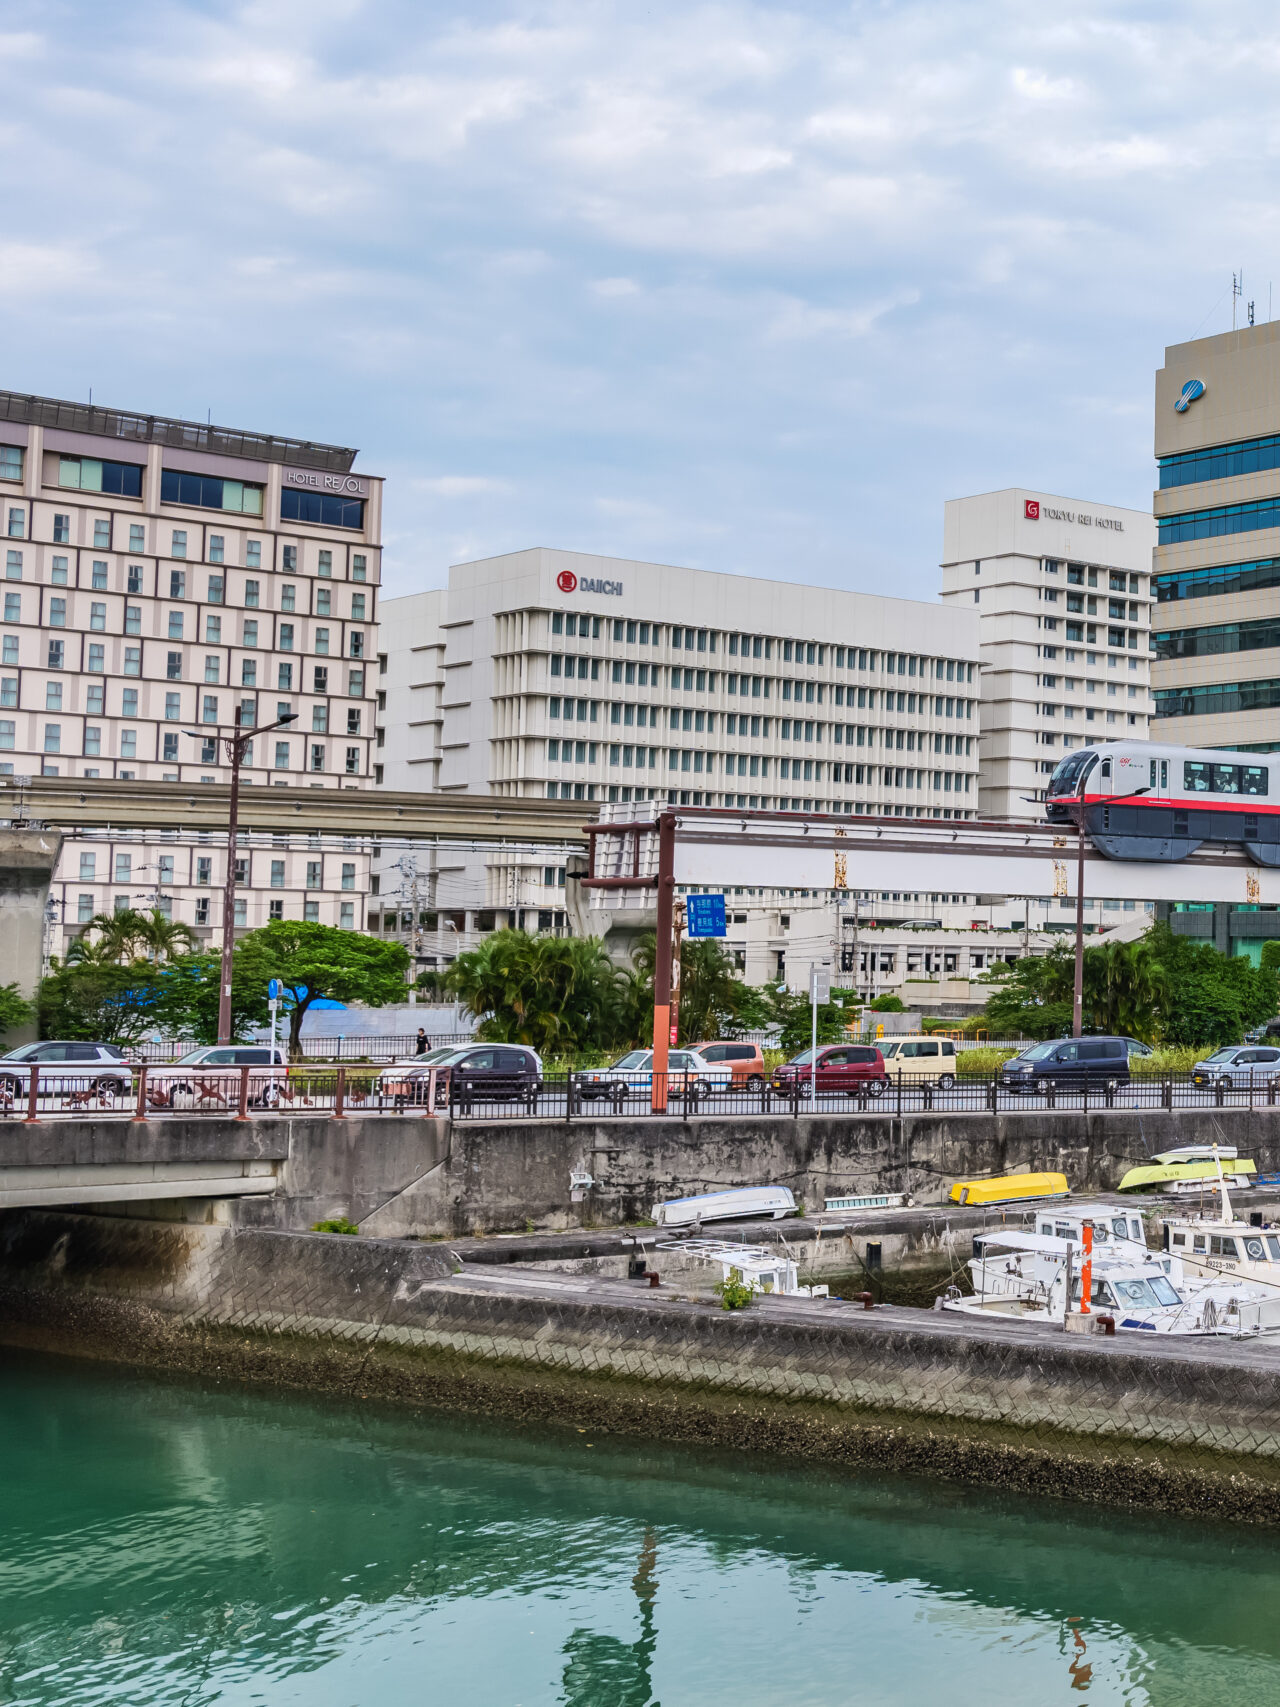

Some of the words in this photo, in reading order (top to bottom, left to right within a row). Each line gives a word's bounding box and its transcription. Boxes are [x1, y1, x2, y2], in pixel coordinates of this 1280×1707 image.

[288, 472, 320, 486] HOTEL
[324, 475, 365, 493] RESOL
[1043, 507, 1075, 522] TOKYU
[1077, 513, 1092, 526] REI
[1095, 517, 1124, 531] HOTEL
[580, 577, 623, 596] DAIICHI
